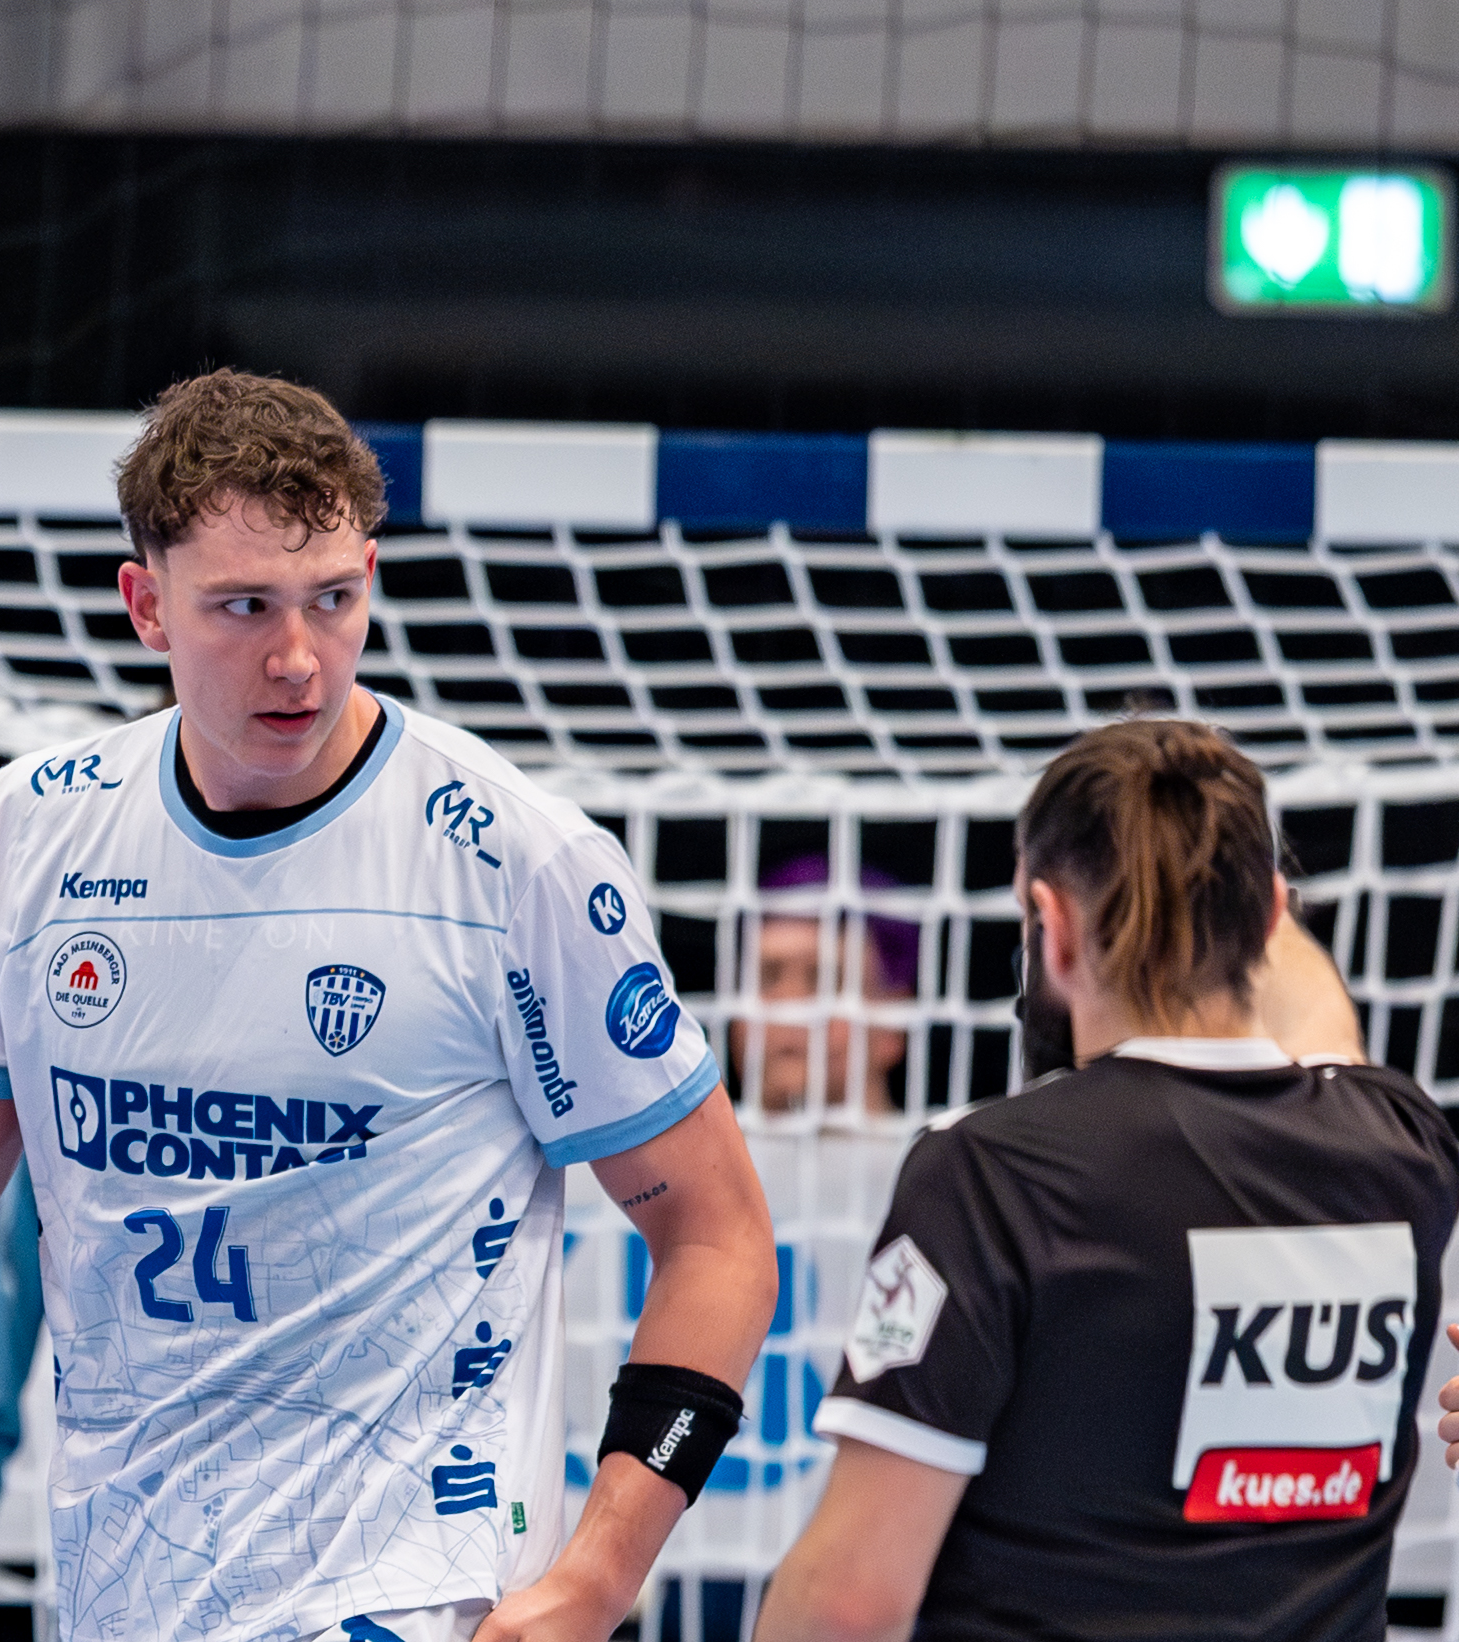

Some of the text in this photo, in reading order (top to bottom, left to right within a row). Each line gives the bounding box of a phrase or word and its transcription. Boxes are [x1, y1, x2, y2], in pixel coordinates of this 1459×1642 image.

[59, 872, 148, 905] Kempa
[53, 940, 120, 985] BAD MEINBERGER
[55, 991, 110, 1009] DIE QUELLE
[322, 990, 351, 1008] TBV
[507, 967, 578, 1120] animonda
[123, 1206, 258, 1323] 24
[1199, 1298, 1408, 1385] KÜS
[646, 1408, 695, 1472] Kempa
[1217, 1459, 1362, 1508] kues.de
